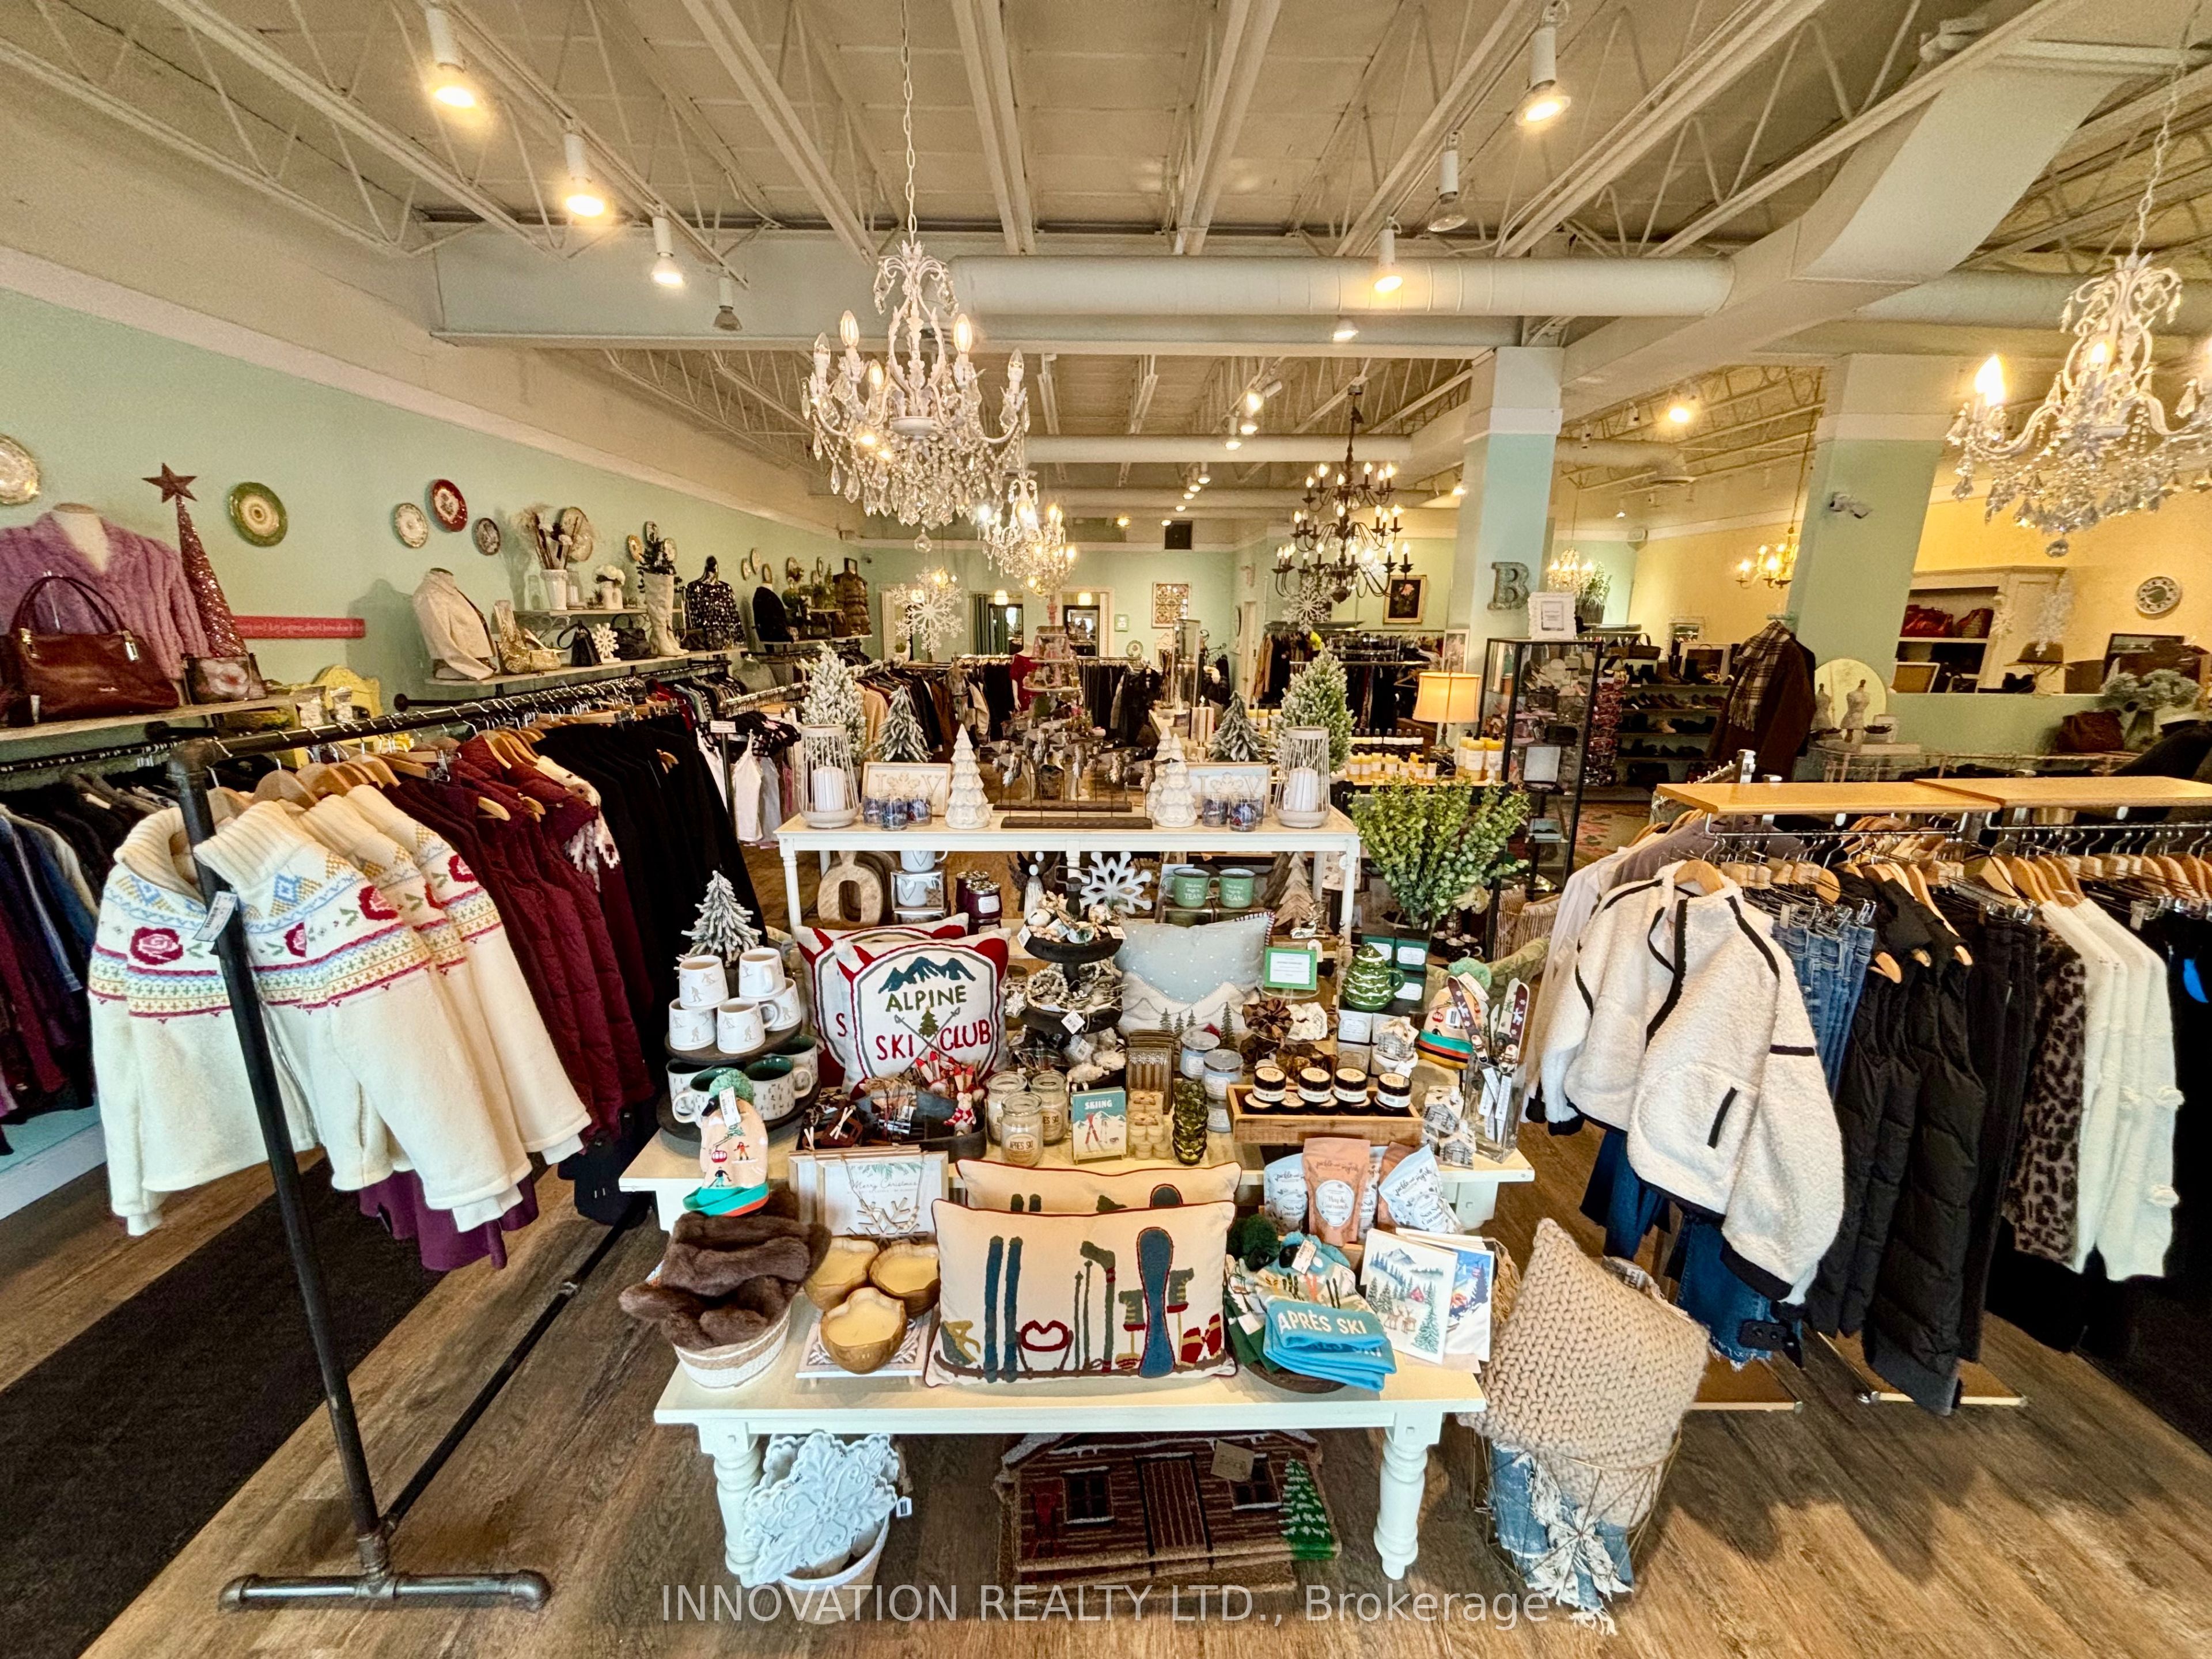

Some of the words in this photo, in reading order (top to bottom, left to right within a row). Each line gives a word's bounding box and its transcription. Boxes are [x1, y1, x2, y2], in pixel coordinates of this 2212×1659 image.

[885, 985, 967, 1012] ALPINE
[876, 1034, 914, 1060] SKI
[940, 1019, 991, 1051] CLUB
[1085, 1100, 1113, 1110] SKIING
[1336, 1317, 1367, 1334] SKI
